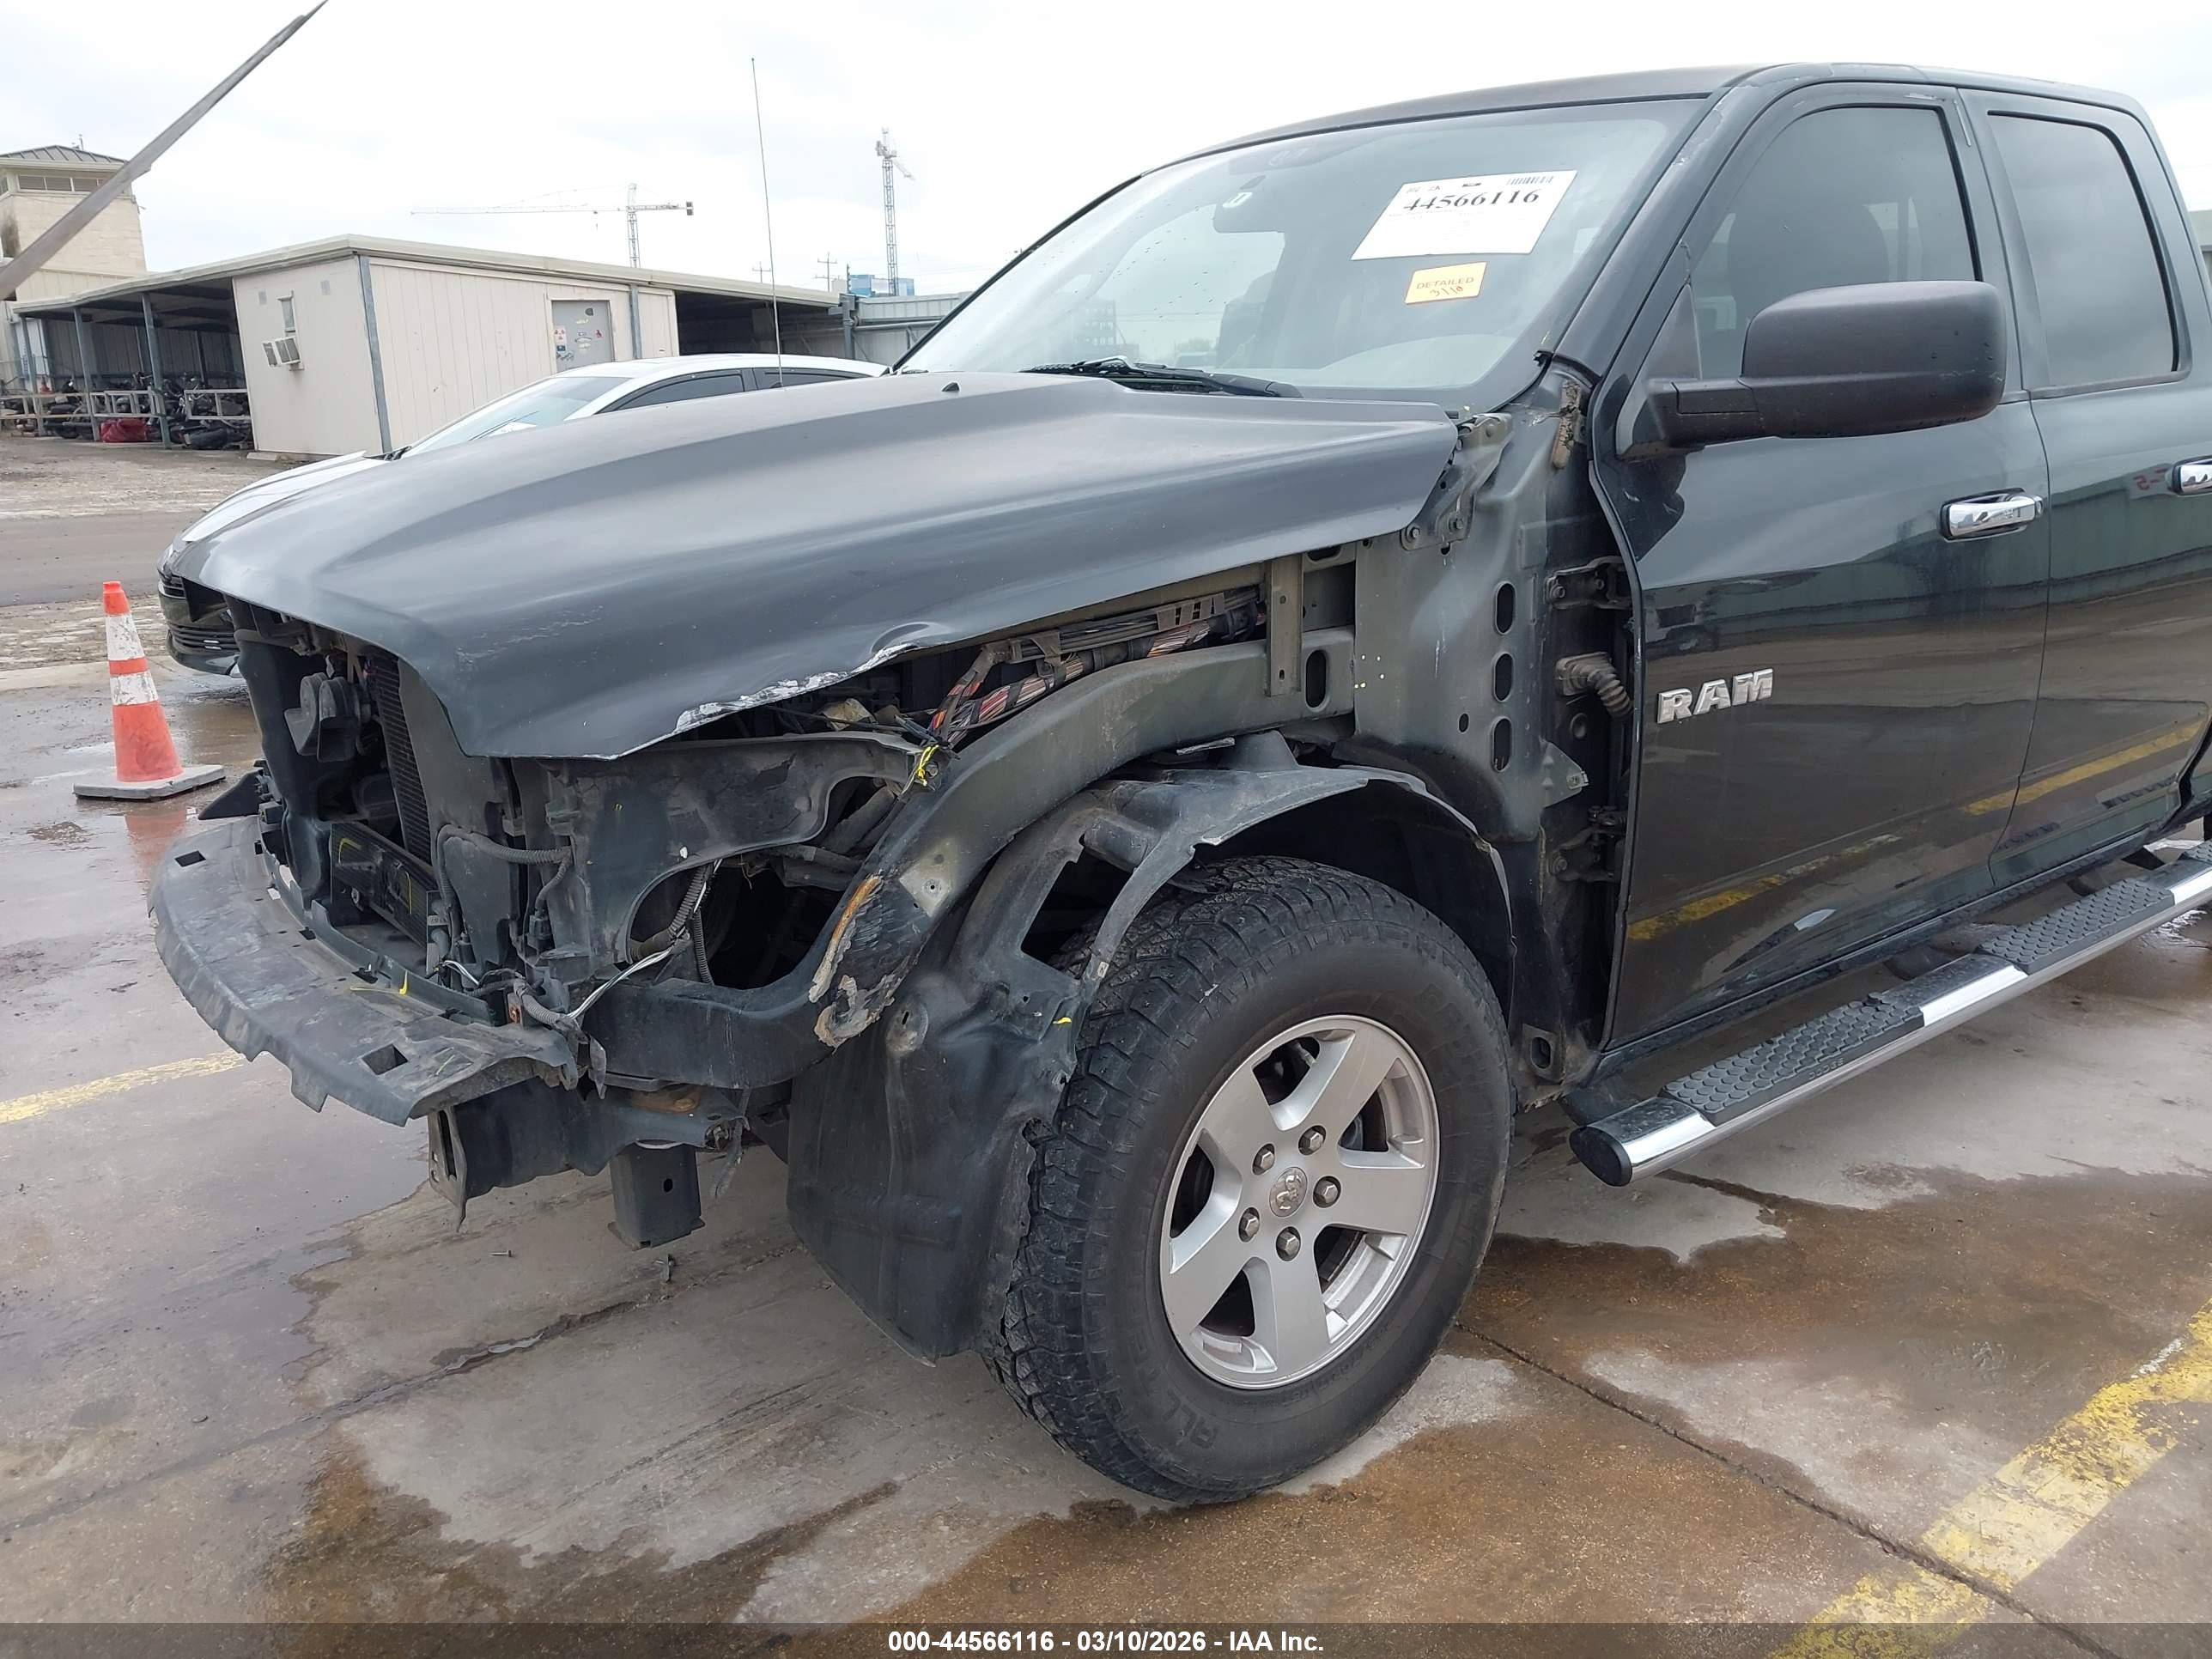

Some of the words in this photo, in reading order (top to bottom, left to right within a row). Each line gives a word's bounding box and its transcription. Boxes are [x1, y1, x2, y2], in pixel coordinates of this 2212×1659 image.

[1403, 188, 1540, 211] 44566116
[1416, 276, 1474, 289] DETAILED
[1657, 668, 1774, 724] RAM
